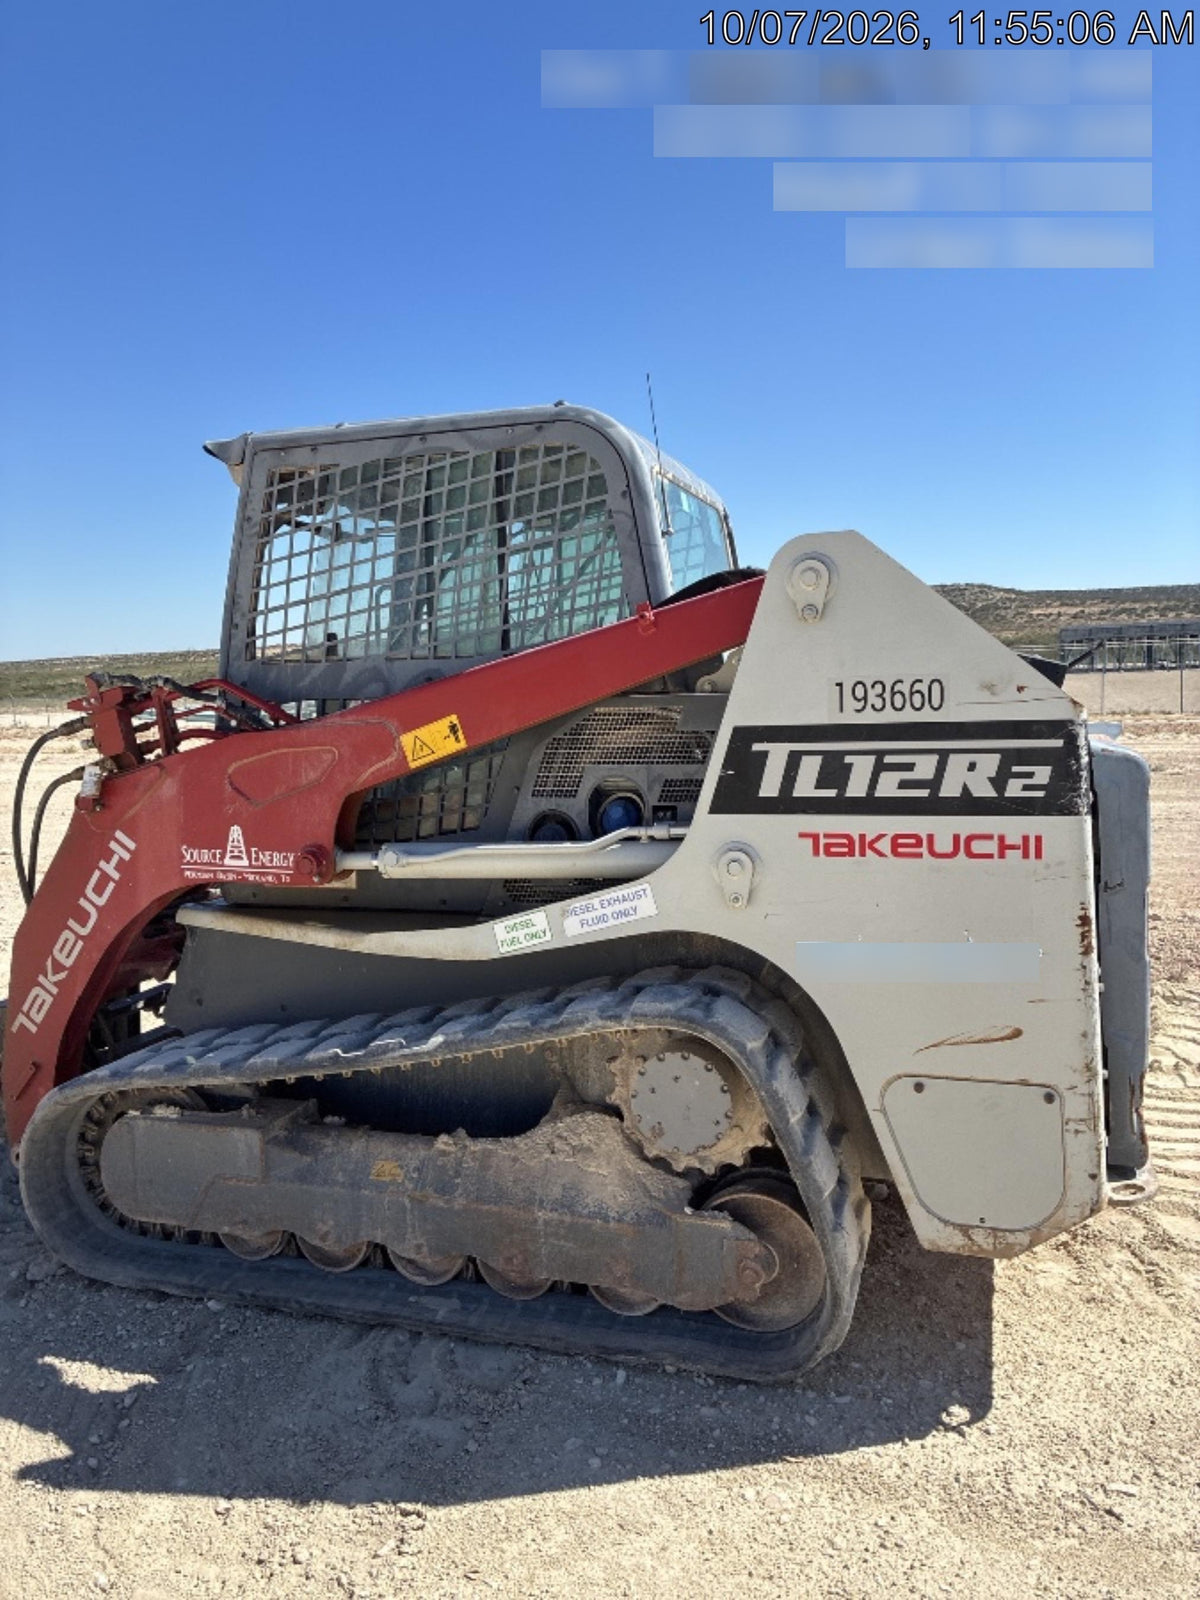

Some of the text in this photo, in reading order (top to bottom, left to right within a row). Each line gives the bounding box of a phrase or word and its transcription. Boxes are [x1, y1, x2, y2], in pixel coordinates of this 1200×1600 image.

[834, 678, 945, 713] 193660
[751, 738, 1064, 798] TL12R2
[181, 845, 295, 867] SOURCE ENERGY
[797, 831, 1043, 860] TAKEUCHI
[599, 888, 648, 909] EXHAUST
[504, 918, 537, 934] DIESEL
[579, 905, 638, 929] FLUID ONLY
[9, 829, 137, 1035] TAKEUCHI
[500, 928, 547, 948] FUEL ONLY
